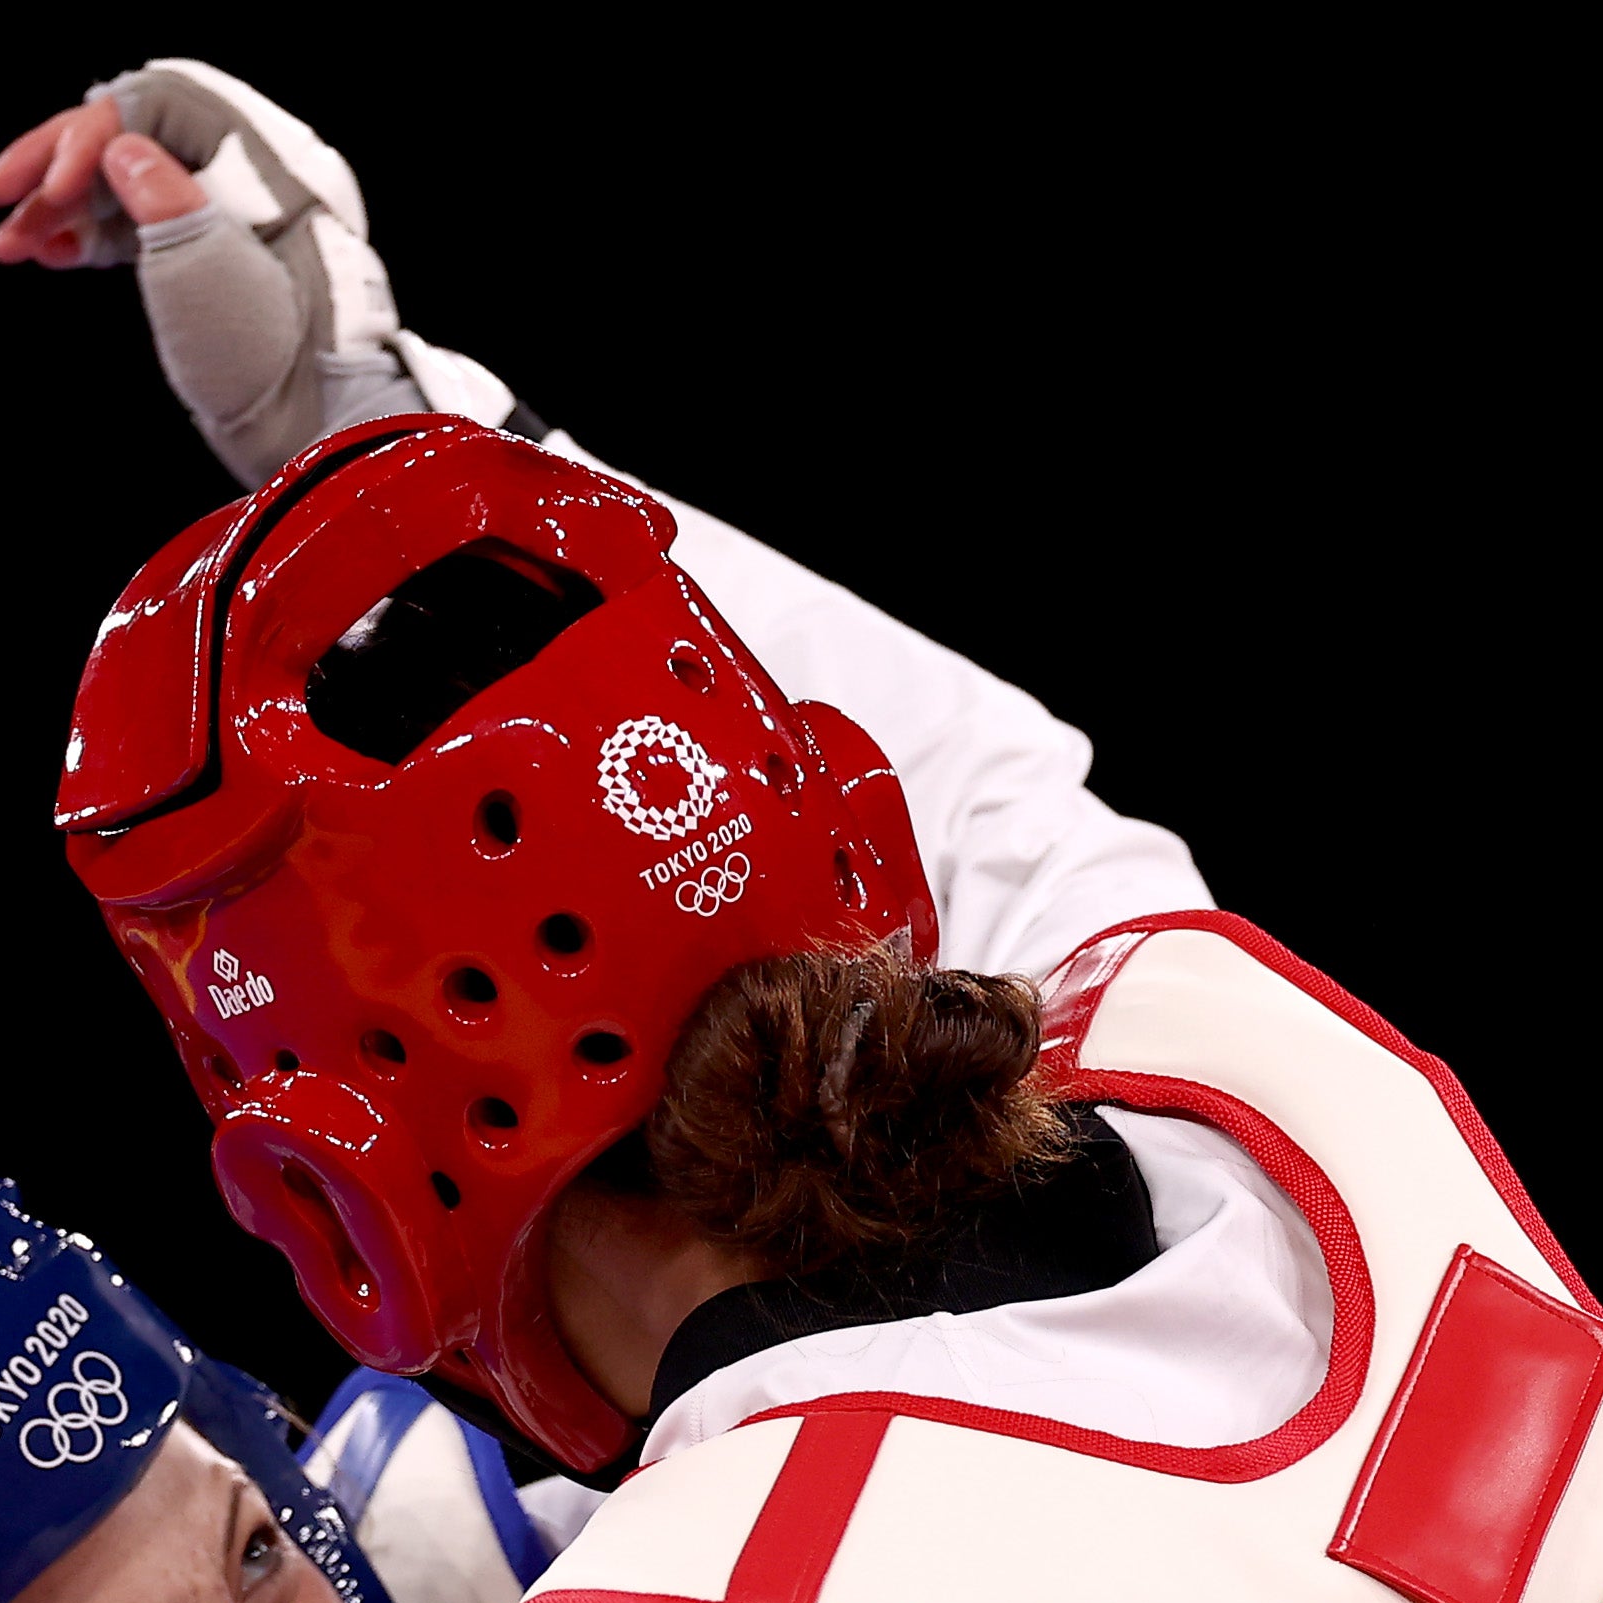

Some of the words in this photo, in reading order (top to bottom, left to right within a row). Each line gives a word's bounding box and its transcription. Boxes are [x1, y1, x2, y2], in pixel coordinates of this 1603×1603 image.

[639, 841, 708, 890] TOKYO
[707, 813, 752, 854] 2020
[24, 1293, 90, 1368] 2020
